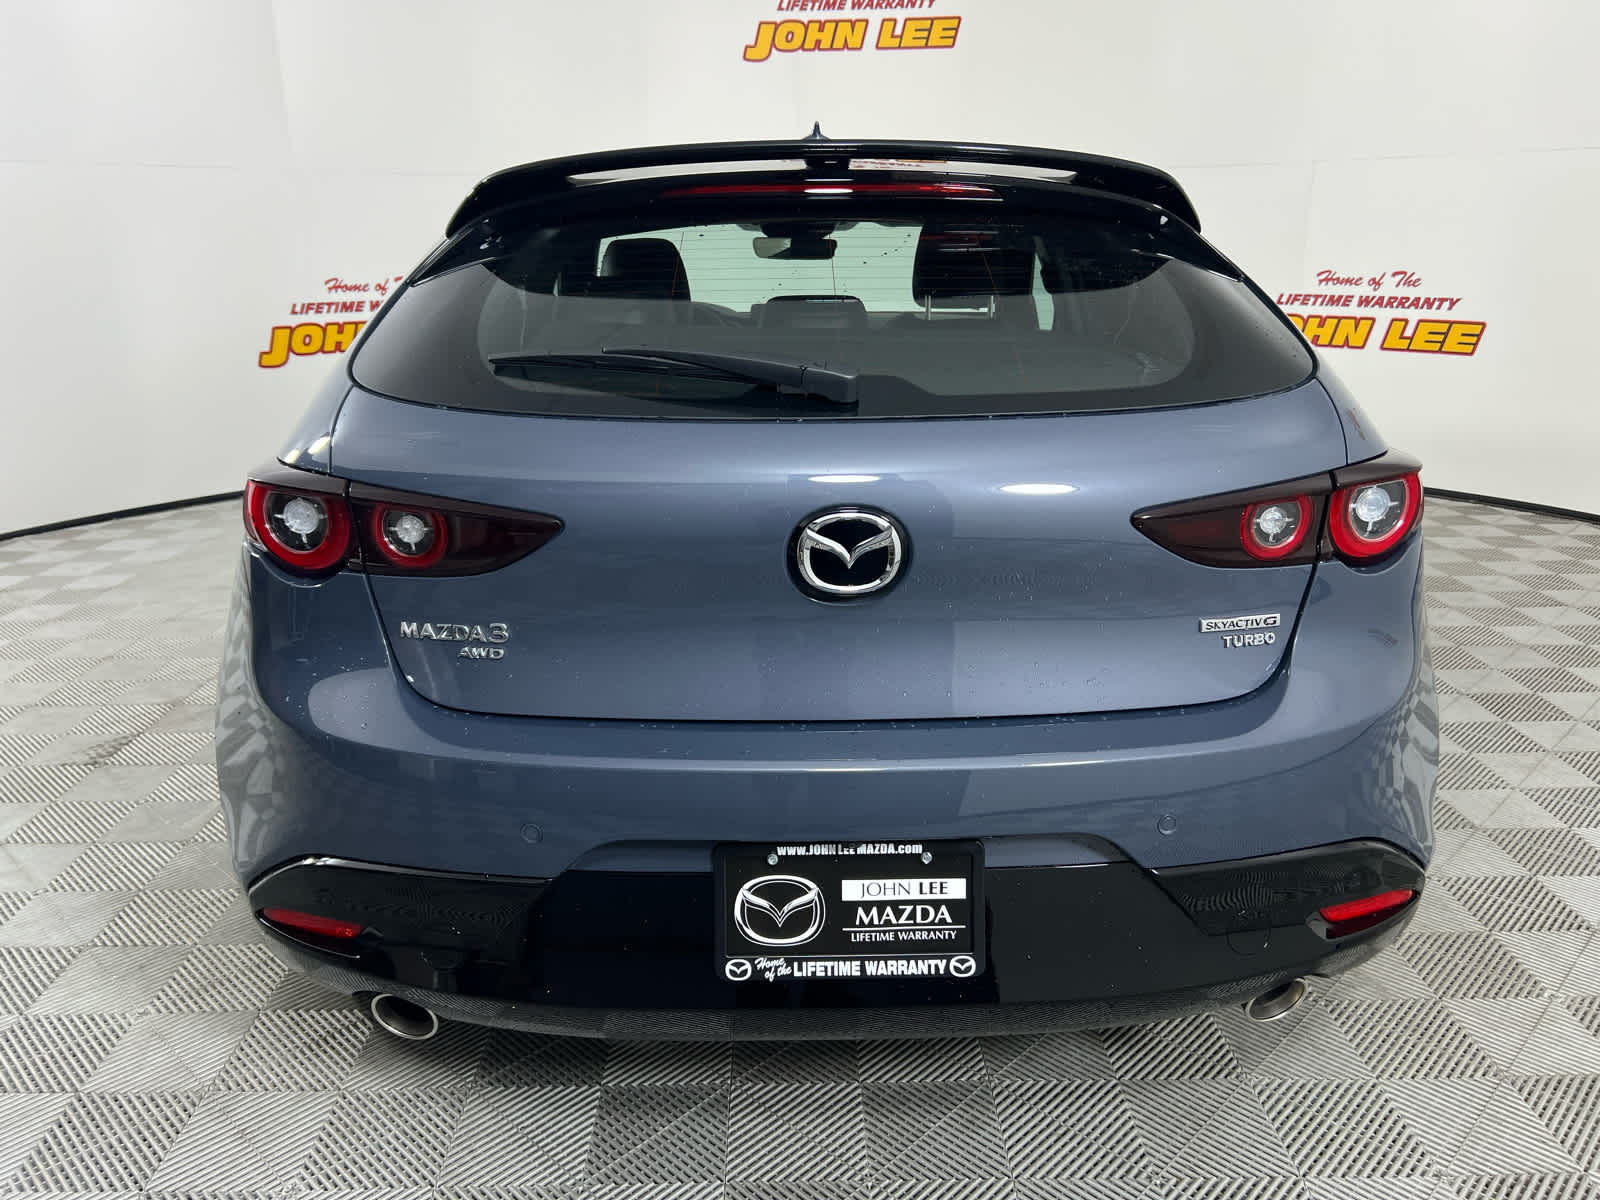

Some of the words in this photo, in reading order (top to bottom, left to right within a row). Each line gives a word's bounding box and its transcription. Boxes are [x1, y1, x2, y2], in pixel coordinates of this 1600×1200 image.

[777, 0, 847, 11] LIFETIME
[851, 0, 936, 10] WARRANTY
[743, 20, 868, 62] JOHN
[876, 16, 961, 50] LEE
[324, 277, 369, 293] Home
[375, 278, 389, 296] of
[1316, 270, 1363, 287] Home
[1367, 272, 1386, 291] of
[1391, 271, 1422, 288] The
[290, 301, 365, 315] LIFETIME
[1276, 293, 1354, 307] LIFETIME
[1357, 295, 1462, 311] WARRANTY
[1286, 313, 1376, 350] HN
[1380, 318, 1487, 356] LEE
[258, 321, 368, 368] JOH
[400, 621, 510, 643] MAZDA3
[1222, 632, 1276, 648] TURBO
[458, 646, 505, 660] AWD
[861, 881, 911, 899] JOHN
[919, 881, 949, 895] LEE
[855, 904, 953, 925] MAZDA
[851, 931, 895, 942] LIFETIME
[898, 930, 957, 941] WARRANTY
[754, 957, 785, 970] Home
[793, 961, 861, 977] LIFETIME
[864, 959, 947, 976] WARRANTY
[764, 966, 776, 983] of
[777, 963, 793, 977] the
